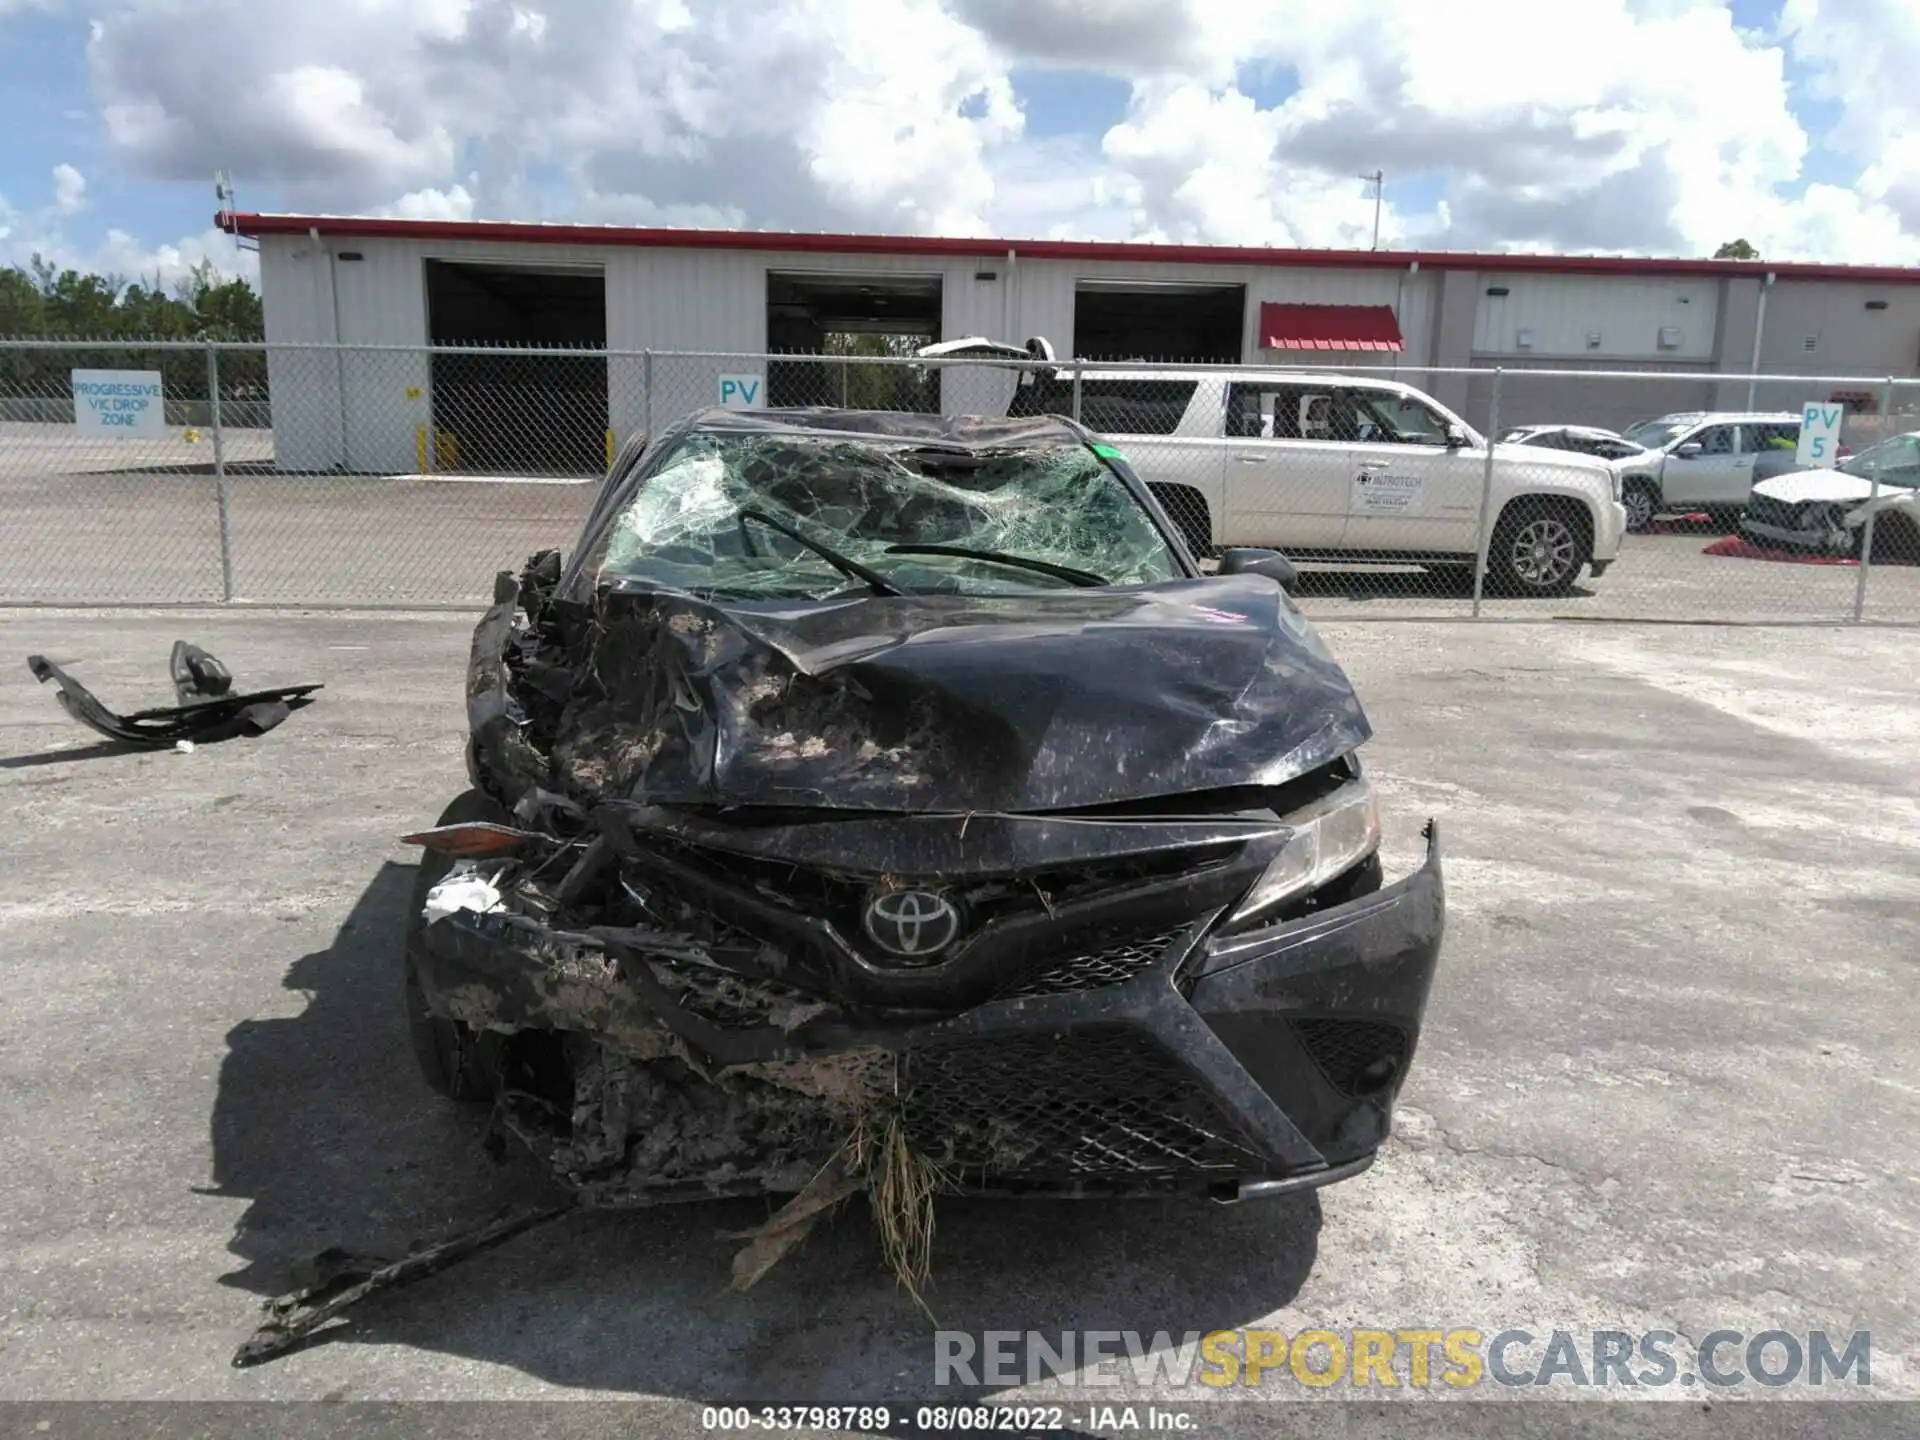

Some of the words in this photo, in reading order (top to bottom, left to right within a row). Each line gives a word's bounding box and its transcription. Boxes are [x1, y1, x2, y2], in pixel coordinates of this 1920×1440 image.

[74, 383, 161, 397] PROGRESSIVE
[721, 380, 759, 404] PV
[88, 398, 111, 411] VIC
[113, 398, 150, 412] DROP
[100, 413, 137, 426] ZONE
[1805, 408, 1839, 430] PV
[1811, 436, 1827, 458] 5
